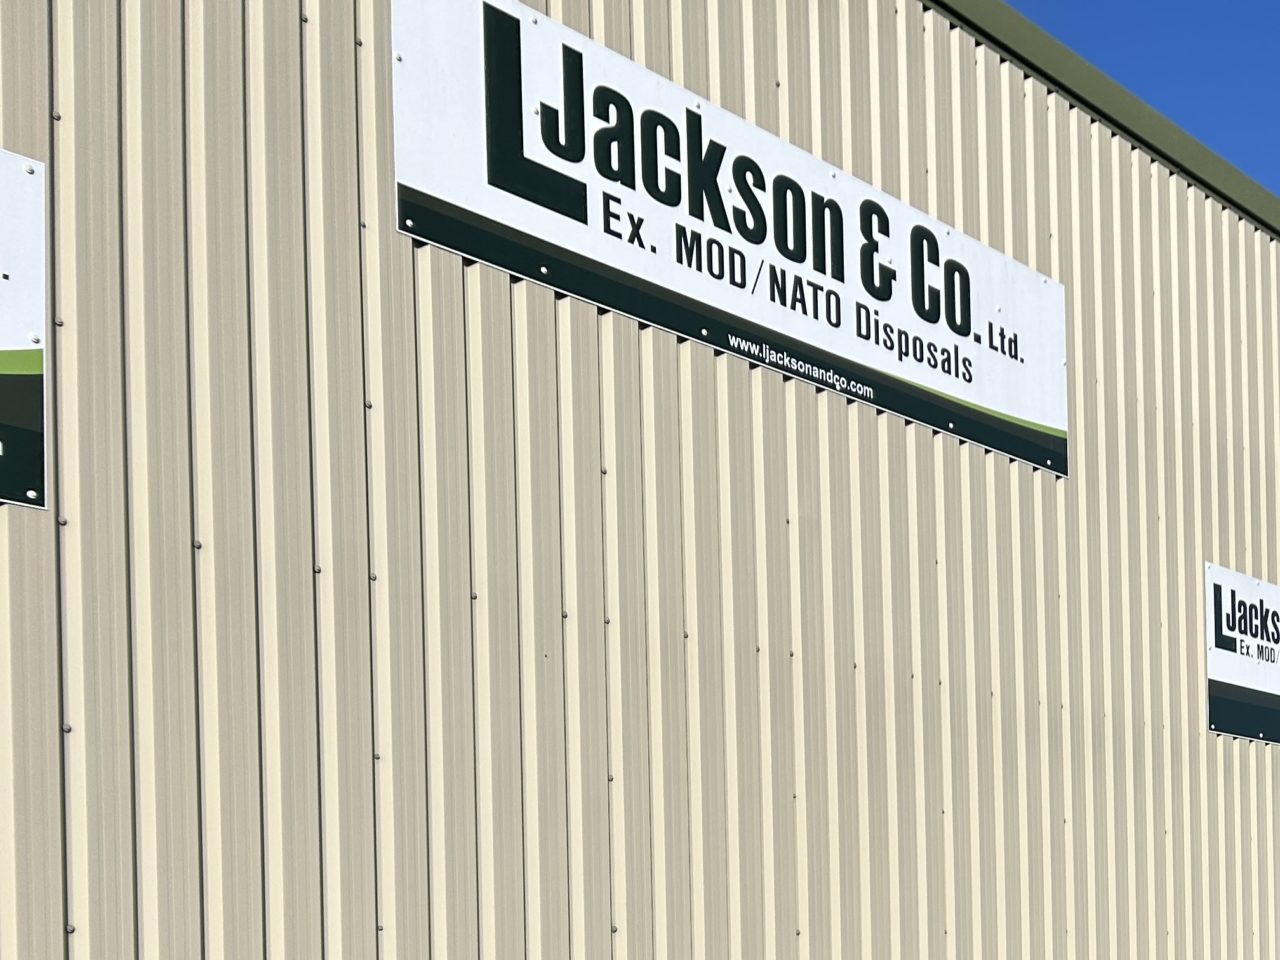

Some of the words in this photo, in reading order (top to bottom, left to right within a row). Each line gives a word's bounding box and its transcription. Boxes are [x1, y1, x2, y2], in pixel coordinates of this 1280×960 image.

[602, 191, 657, 254] Ex.
[675, 223, 842, 328] MOD/NATO
[855, 301, 973, 384] Disposals
[859, 199, 897, 302] &
[910, 224, 982, 345] Co.
[988, 321, 1025, 364] Ltd.
[728, 334, 874, 399] www.ljacksonandco.com
[1240, 639, 1253, 658] Ex.
